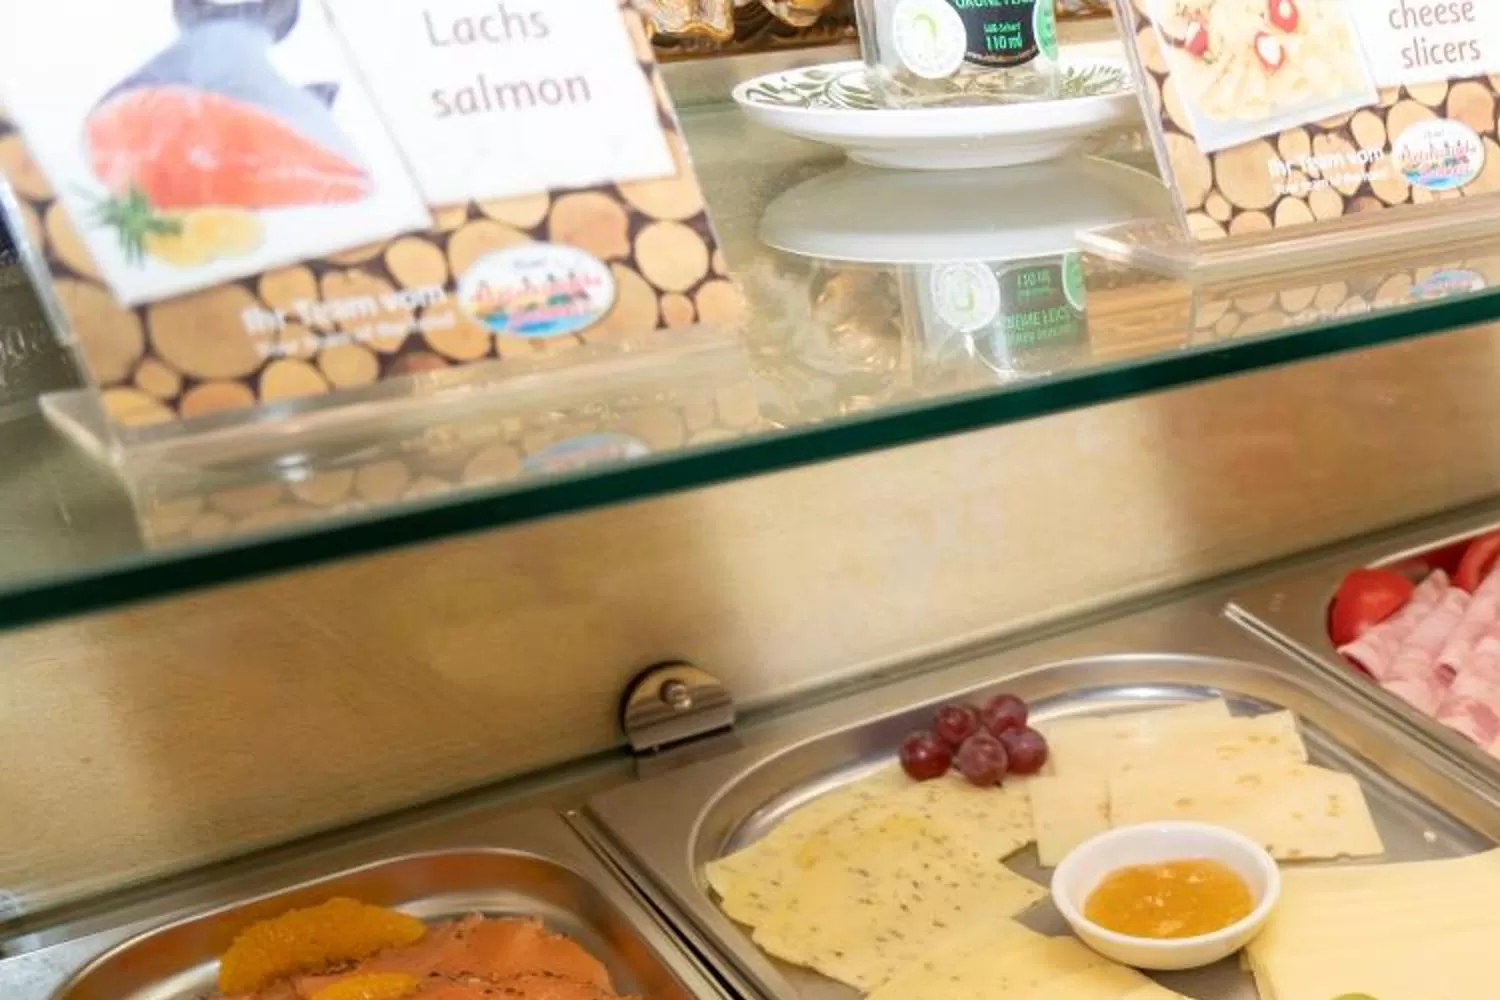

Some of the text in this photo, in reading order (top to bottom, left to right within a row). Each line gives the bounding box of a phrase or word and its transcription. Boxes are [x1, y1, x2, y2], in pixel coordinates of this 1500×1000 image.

[422, 3, 551, 47] Lachs
[1388, 0, 1476, 30] cheese
[986, 36, 1007, 50] 110
[1400, 36, 1482, 70] slicers
[431, 72, 592, 120] salmon
